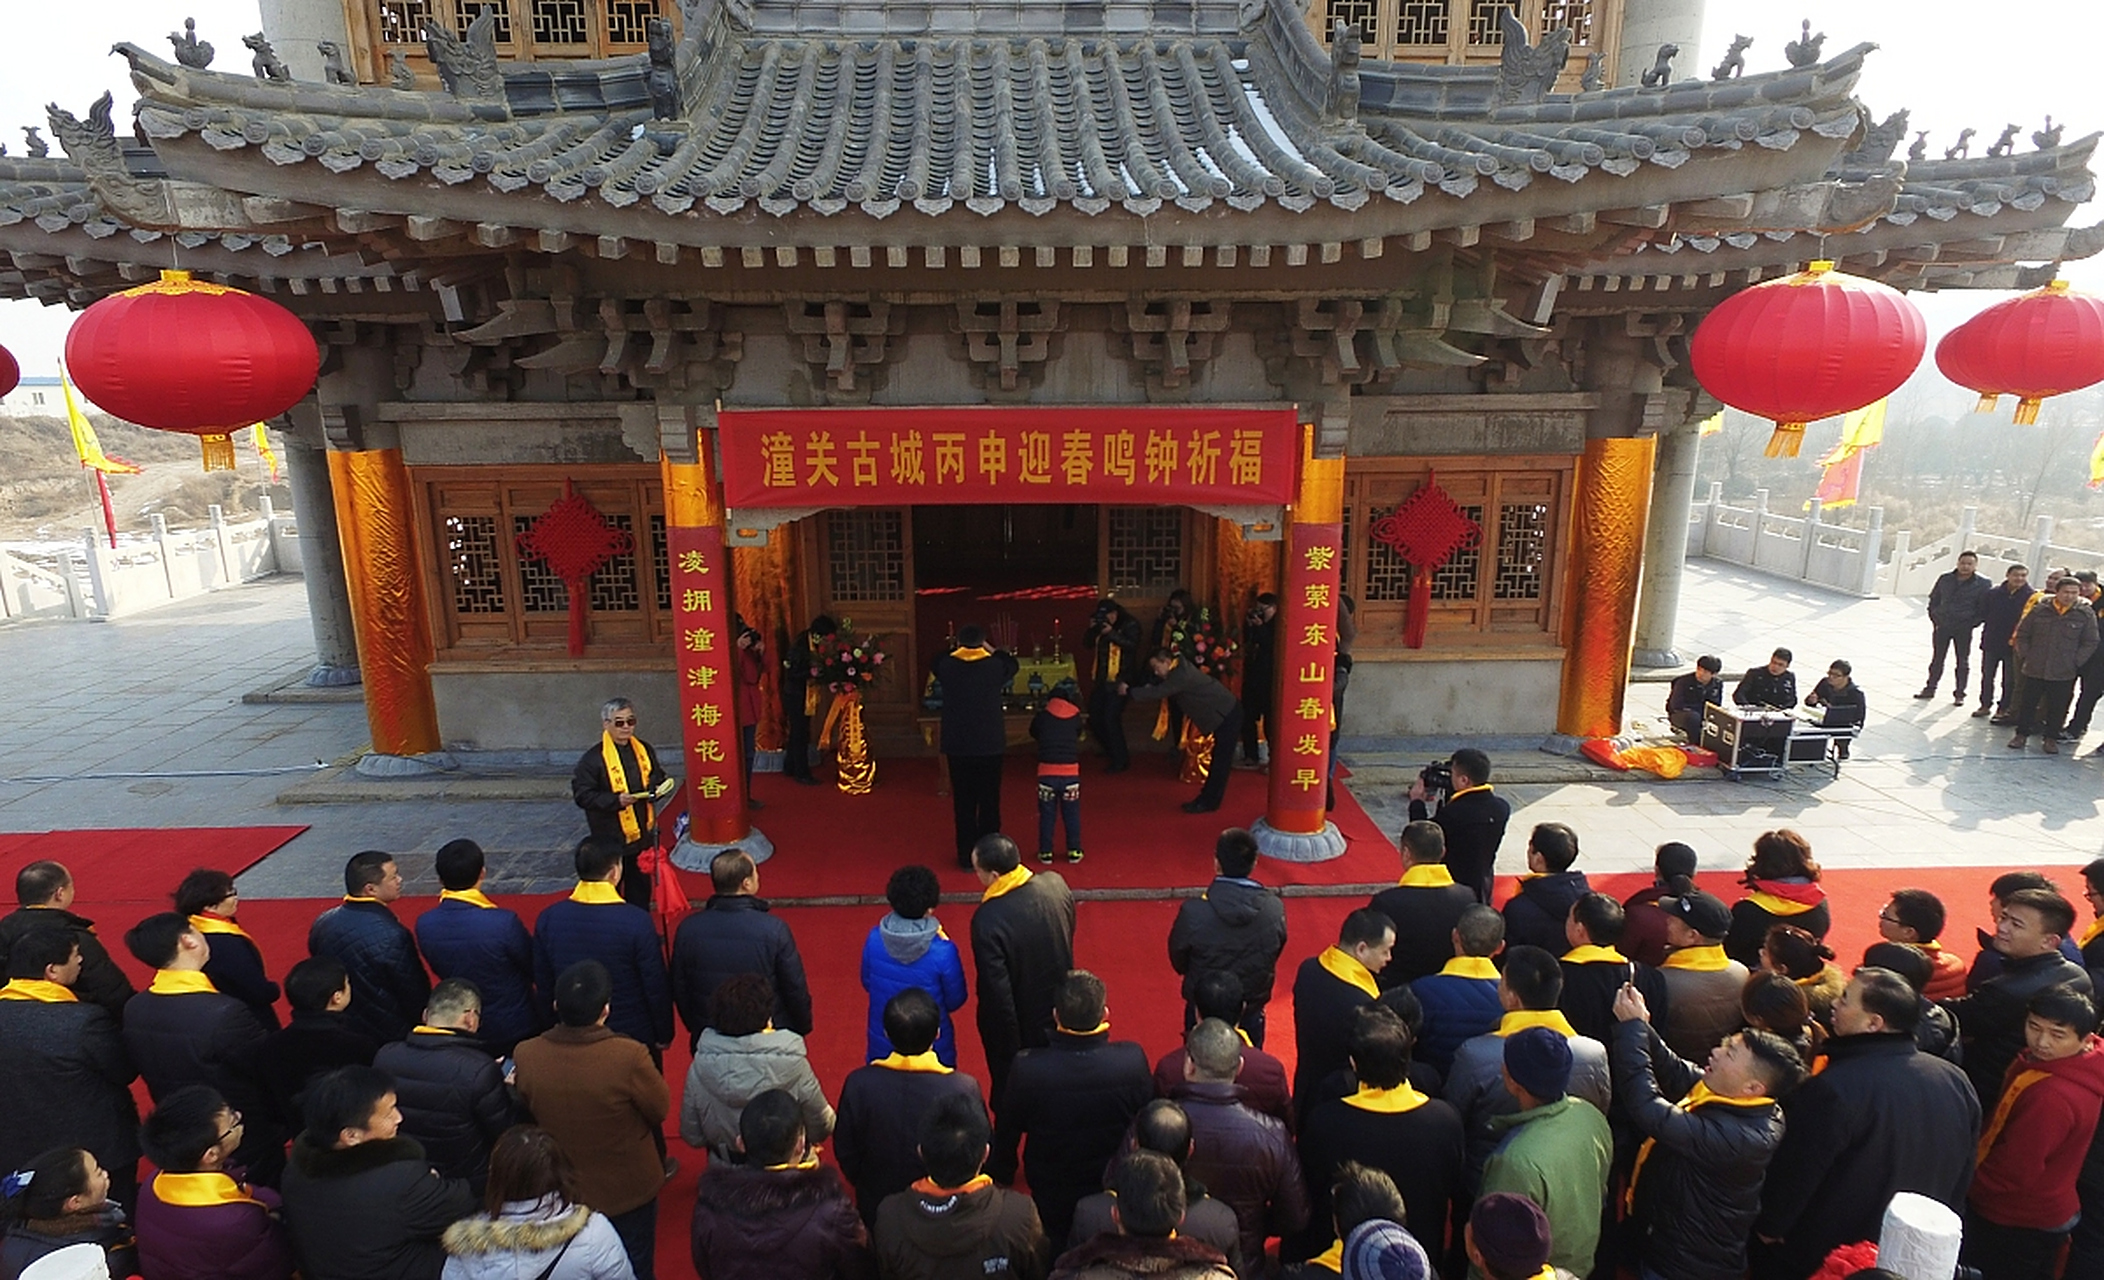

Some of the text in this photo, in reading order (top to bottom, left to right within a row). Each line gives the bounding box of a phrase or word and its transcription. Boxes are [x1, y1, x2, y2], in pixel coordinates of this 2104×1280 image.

[761, 429, 1263, 488] 潼关古城丙申迎春鸣钟祈福
[678, 550, 728, 799] 凌拥潼津梅花香
